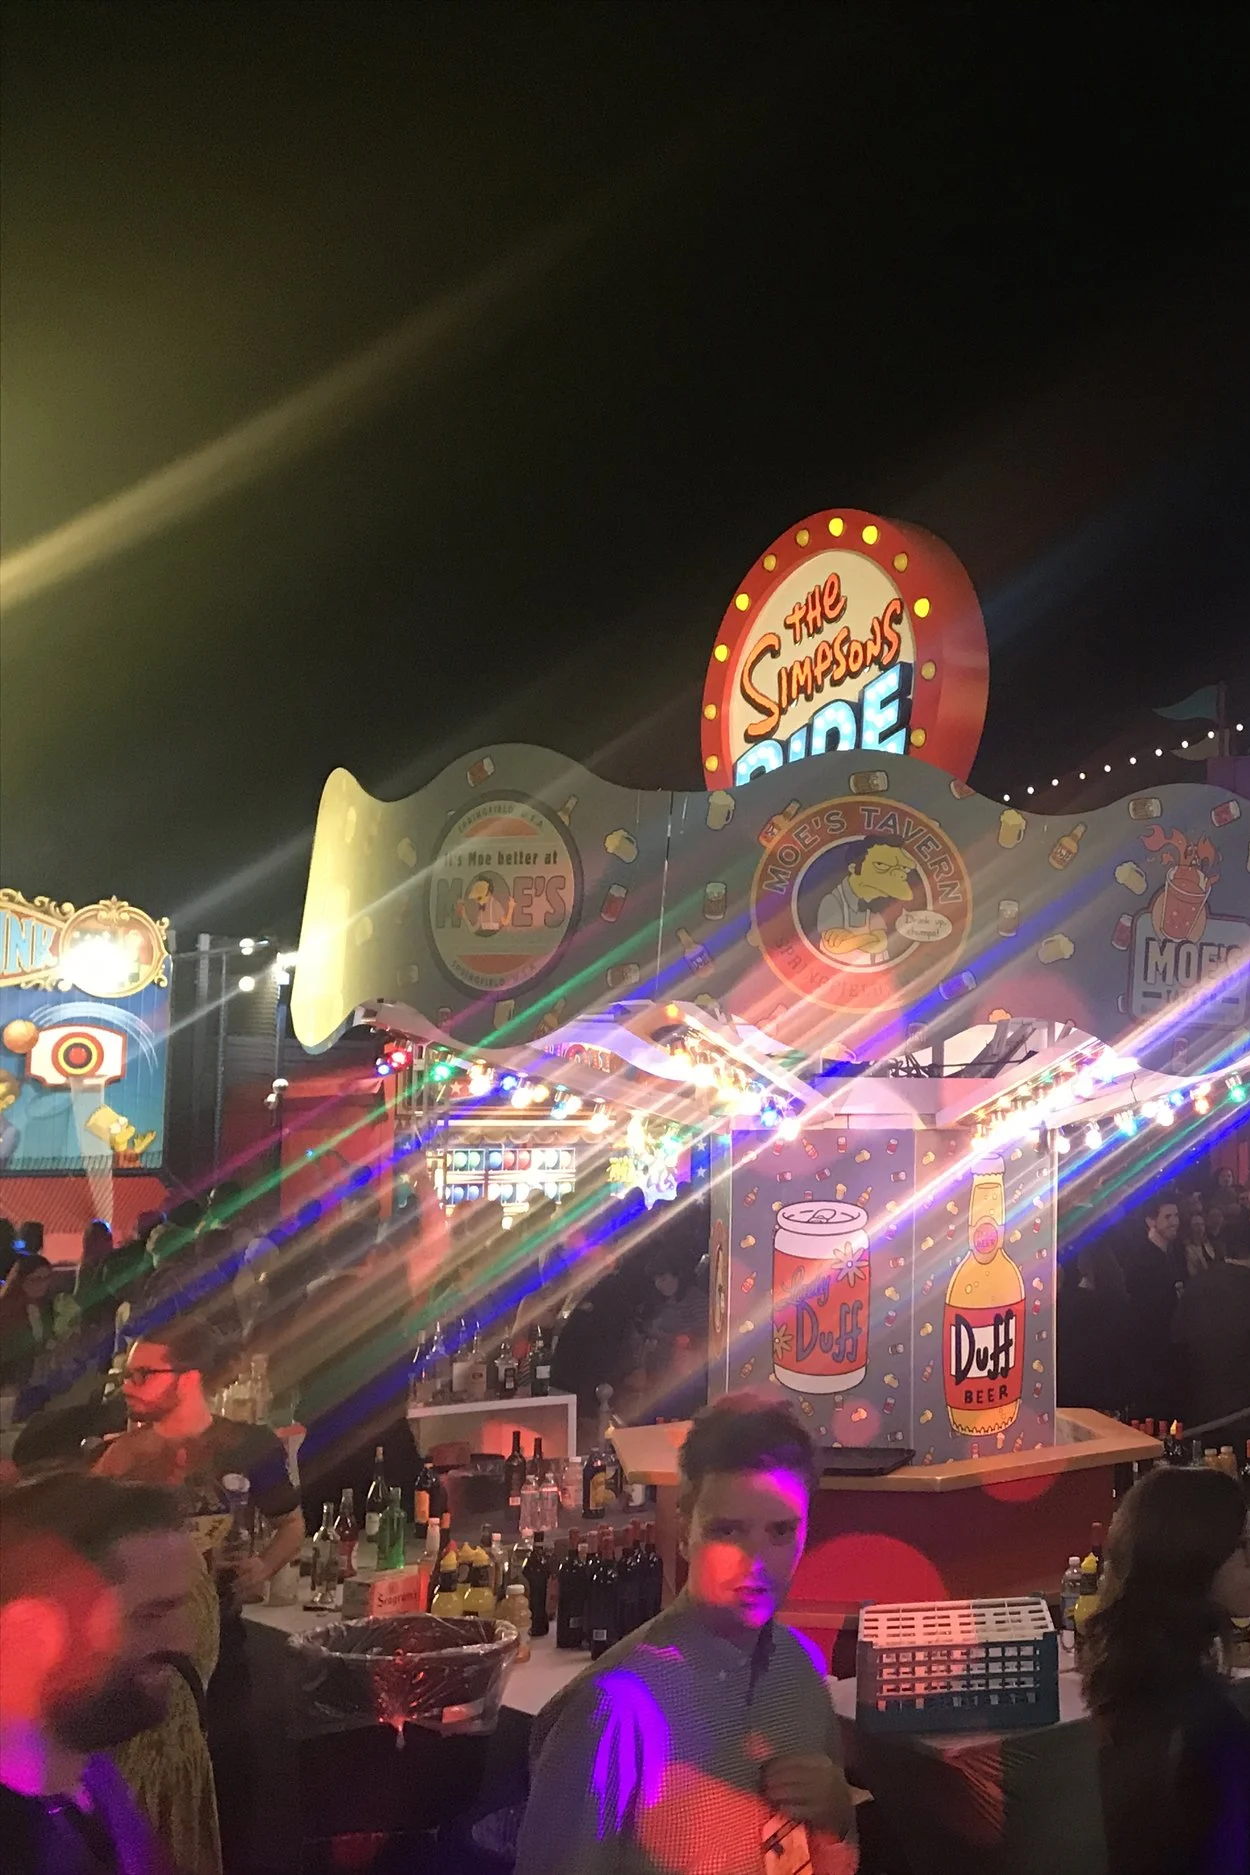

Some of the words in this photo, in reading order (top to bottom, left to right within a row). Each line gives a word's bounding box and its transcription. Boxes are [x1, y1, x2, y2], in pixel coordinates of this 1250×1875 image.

[741, 597, 904, 743] SIMPSONS
[468, 850, 492, 866] Moe
[498, 849, 539, 866] better
[544, 849, 558, 866] at
[762, 809, 847, 896] MOE'S
[859, 806, 963, 905] TAVERN
[795, 1299, 863, 1363] Duff
[954, 1308, 1014, 1386] Duff
[963, 1383, 1009, 1405] BEER
